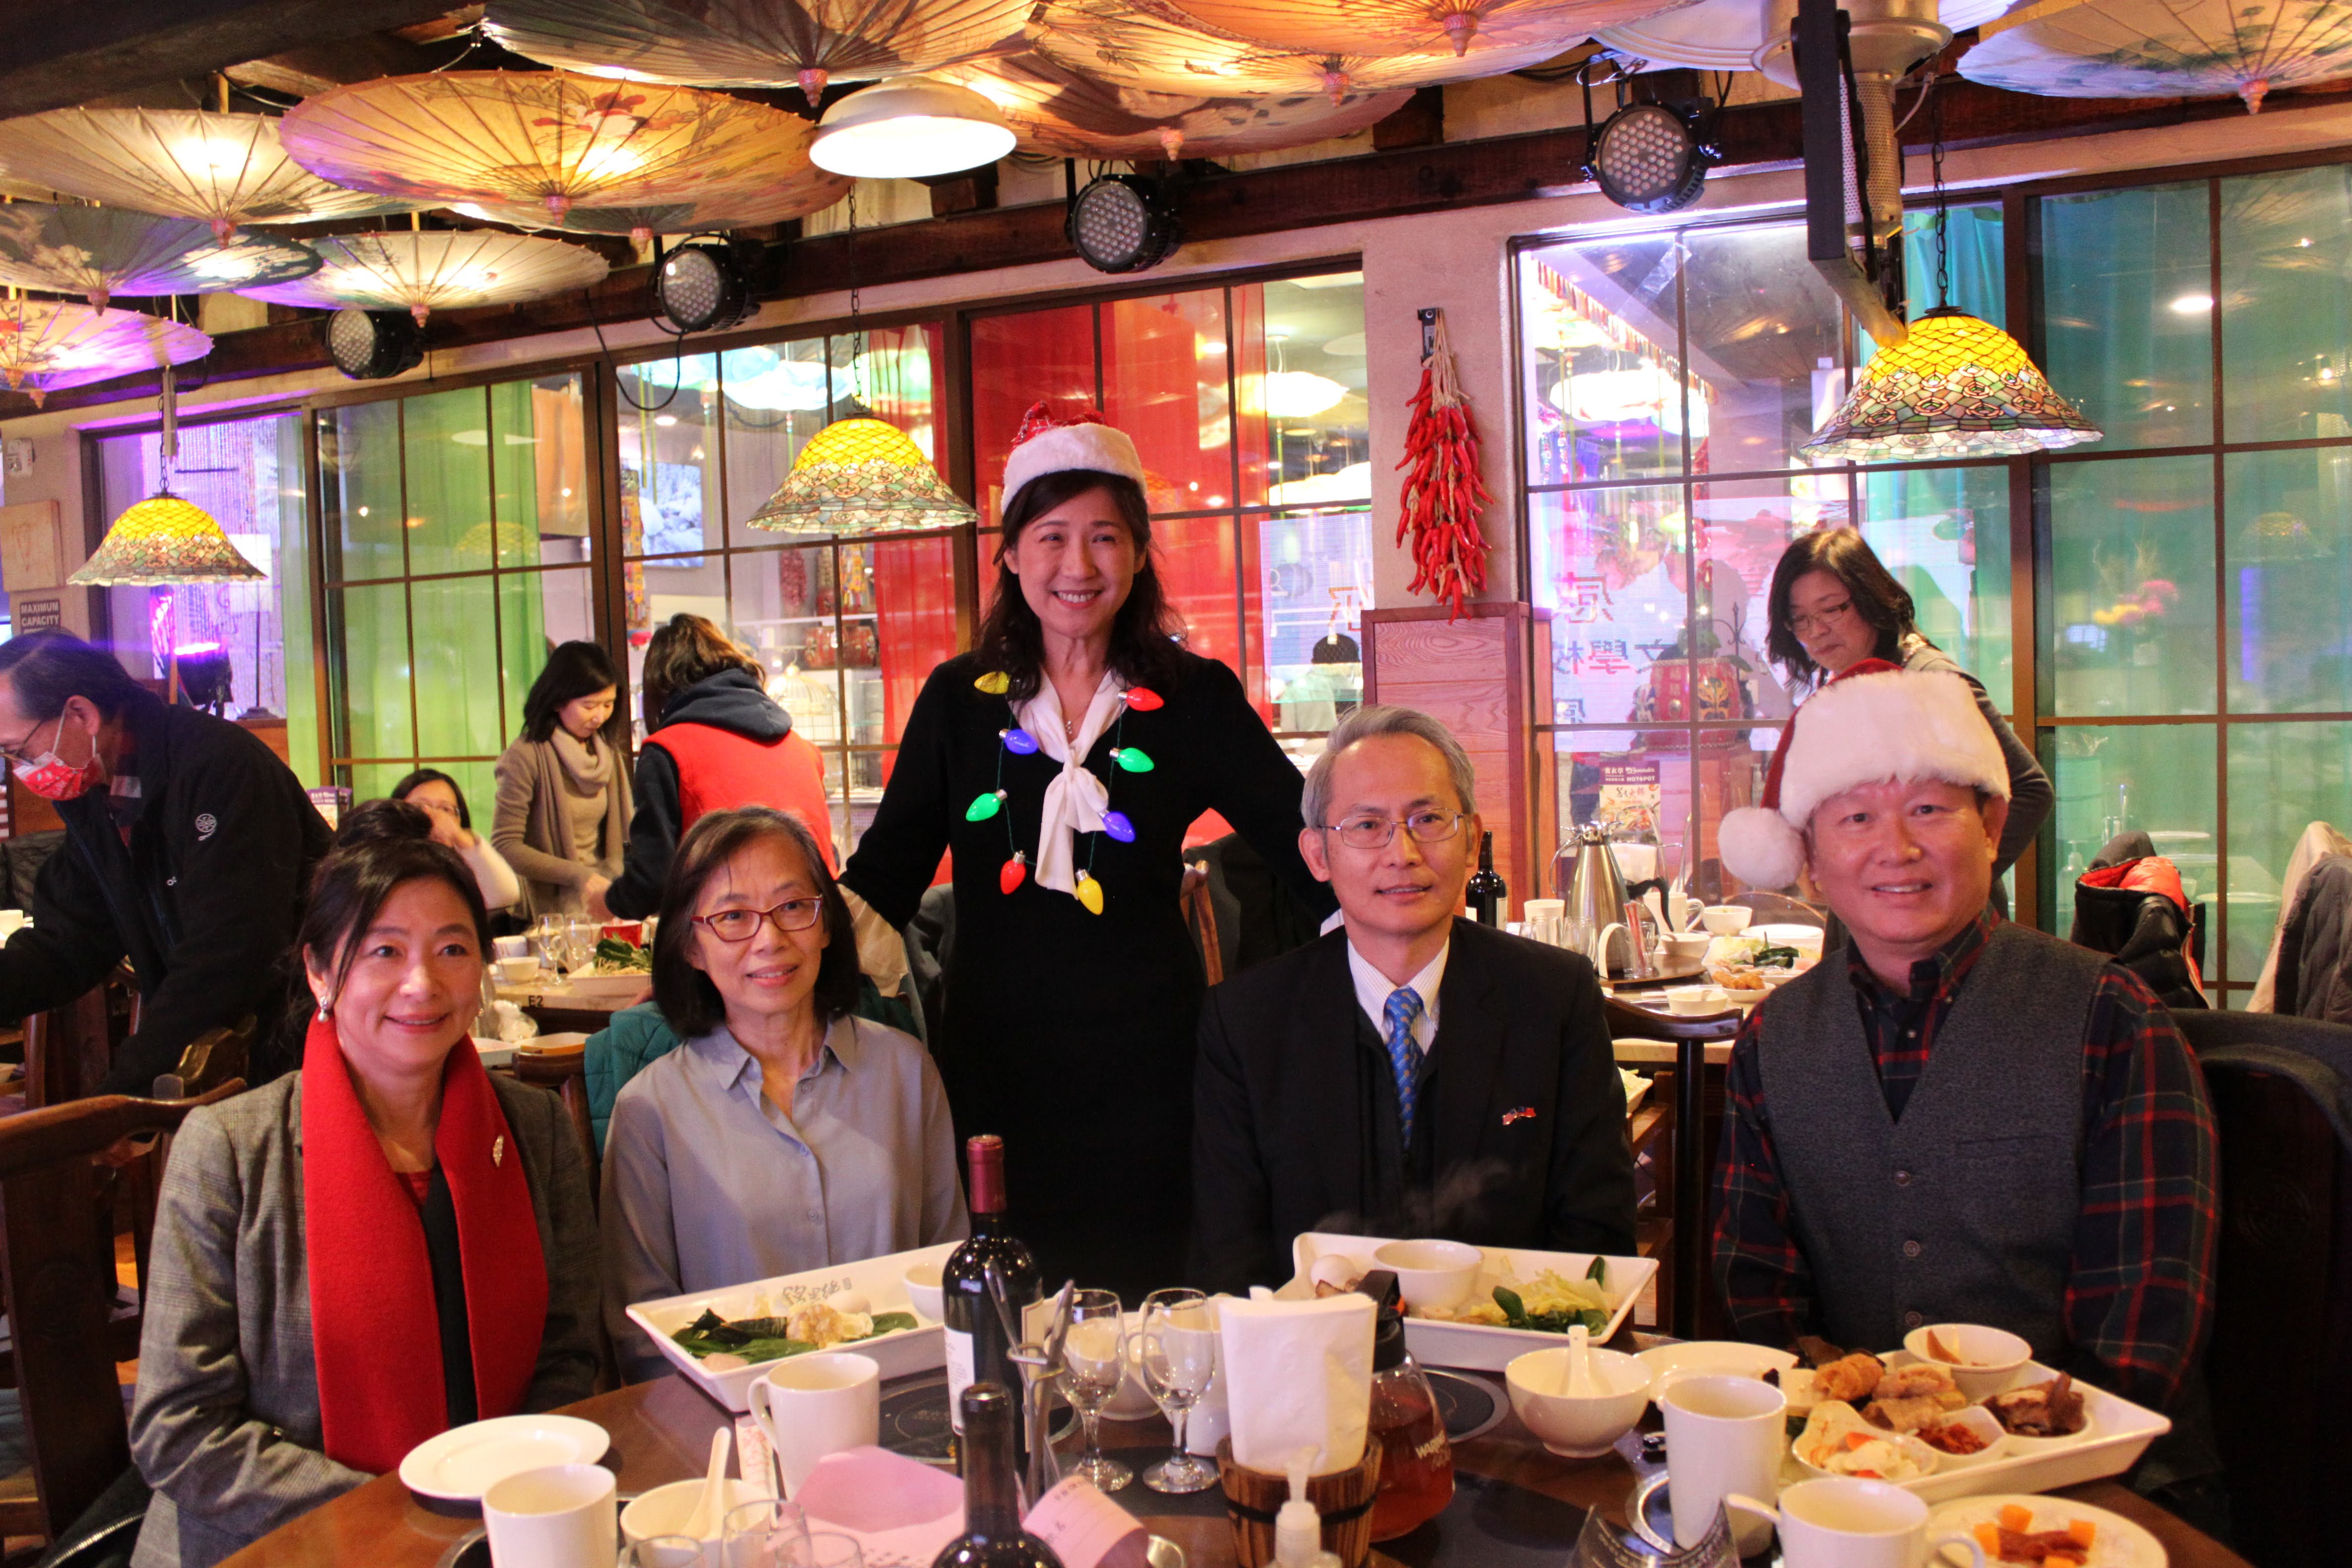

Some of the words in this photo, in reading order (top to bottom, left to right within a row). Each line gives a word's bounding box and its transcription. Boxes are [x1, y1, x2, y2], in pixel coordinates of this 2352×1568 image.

[21, 601, 59, 614] MAXIMUM
[22, 615, 59, 627] CAPACITY
[528, 995, 543, 1007] E2
